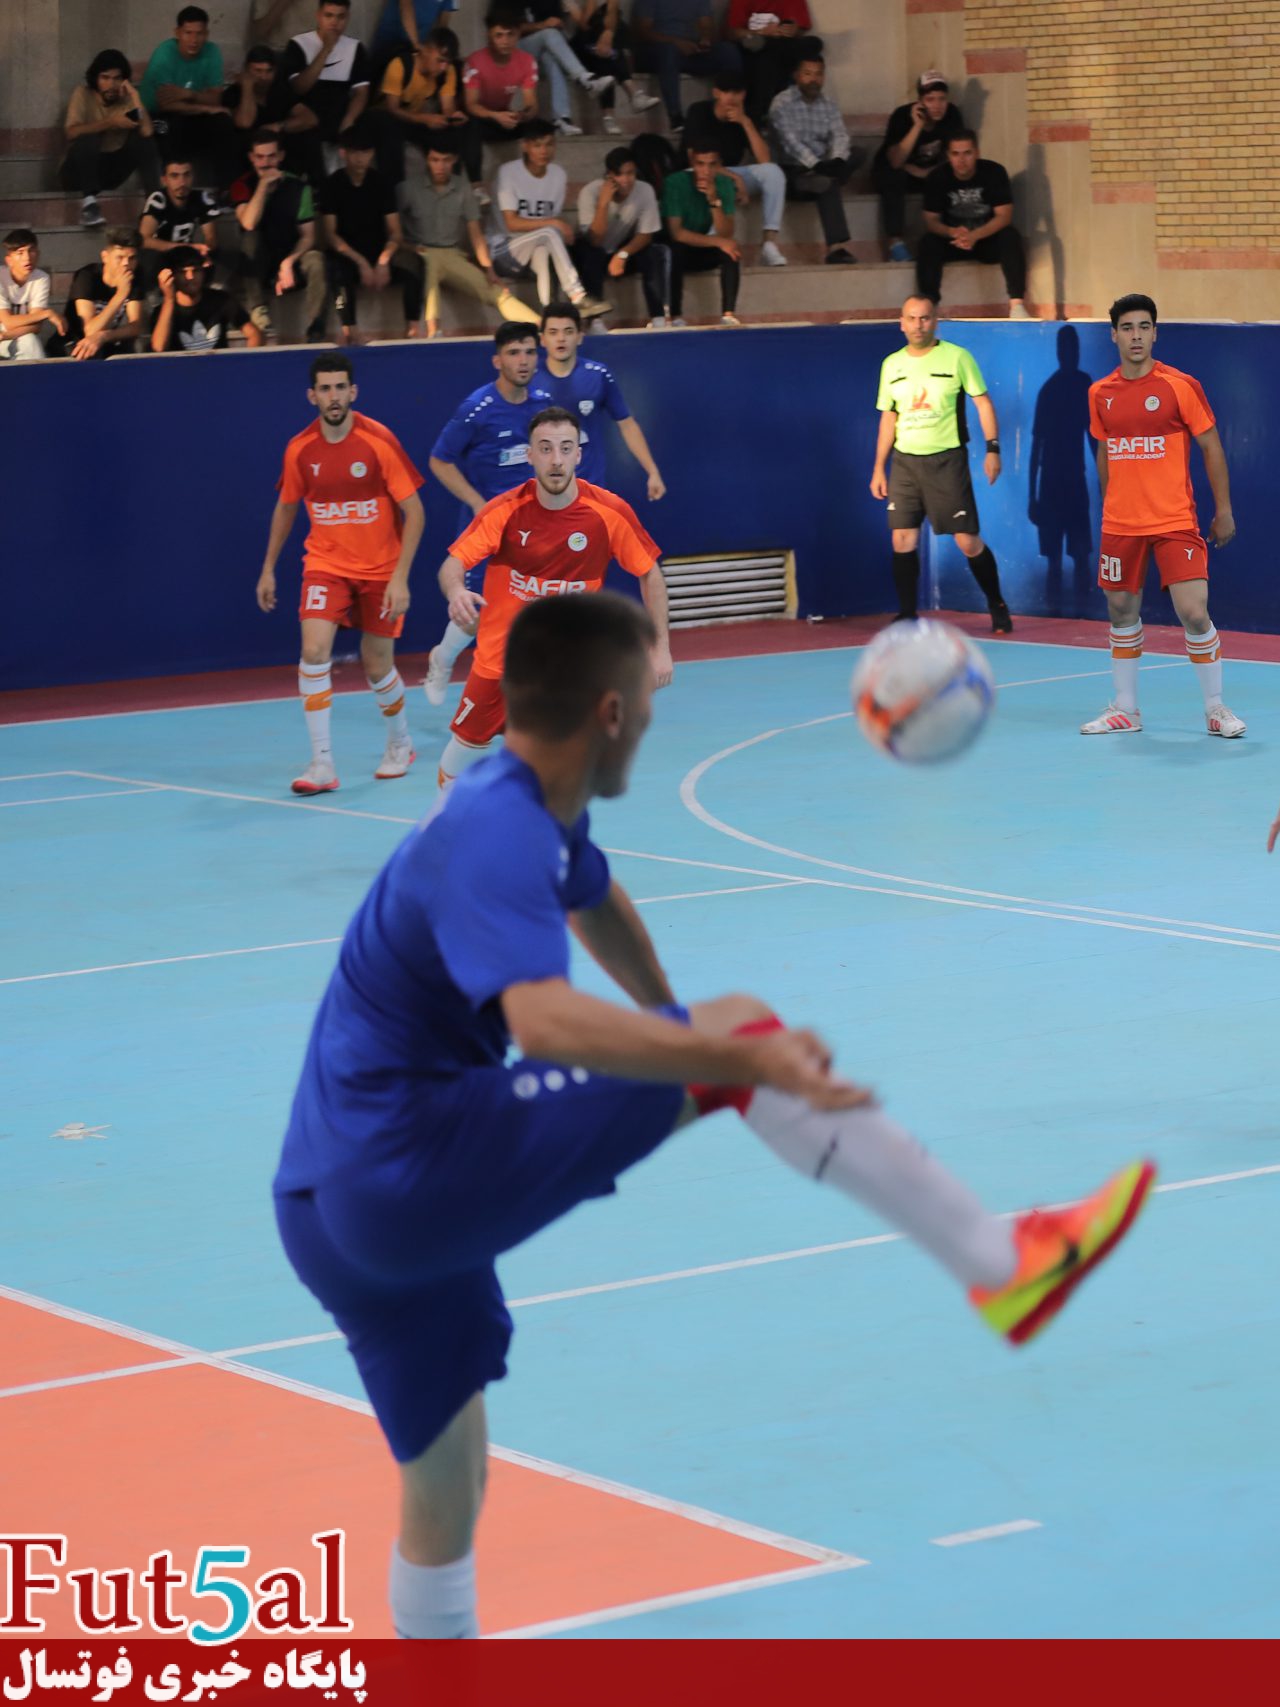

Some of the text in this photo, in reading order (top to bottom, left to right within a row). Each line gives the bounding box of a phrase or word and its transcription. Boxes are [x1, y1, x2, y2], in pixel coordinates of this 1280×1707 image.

[1107, 436, 1166, 454] SAFIR
[312, 499, 379, 518] SAFIR
[1100, 553, 1122, 582] 20
[510, 569, 586, 597] SAFIR
[305, 585, 328, 610] 15
